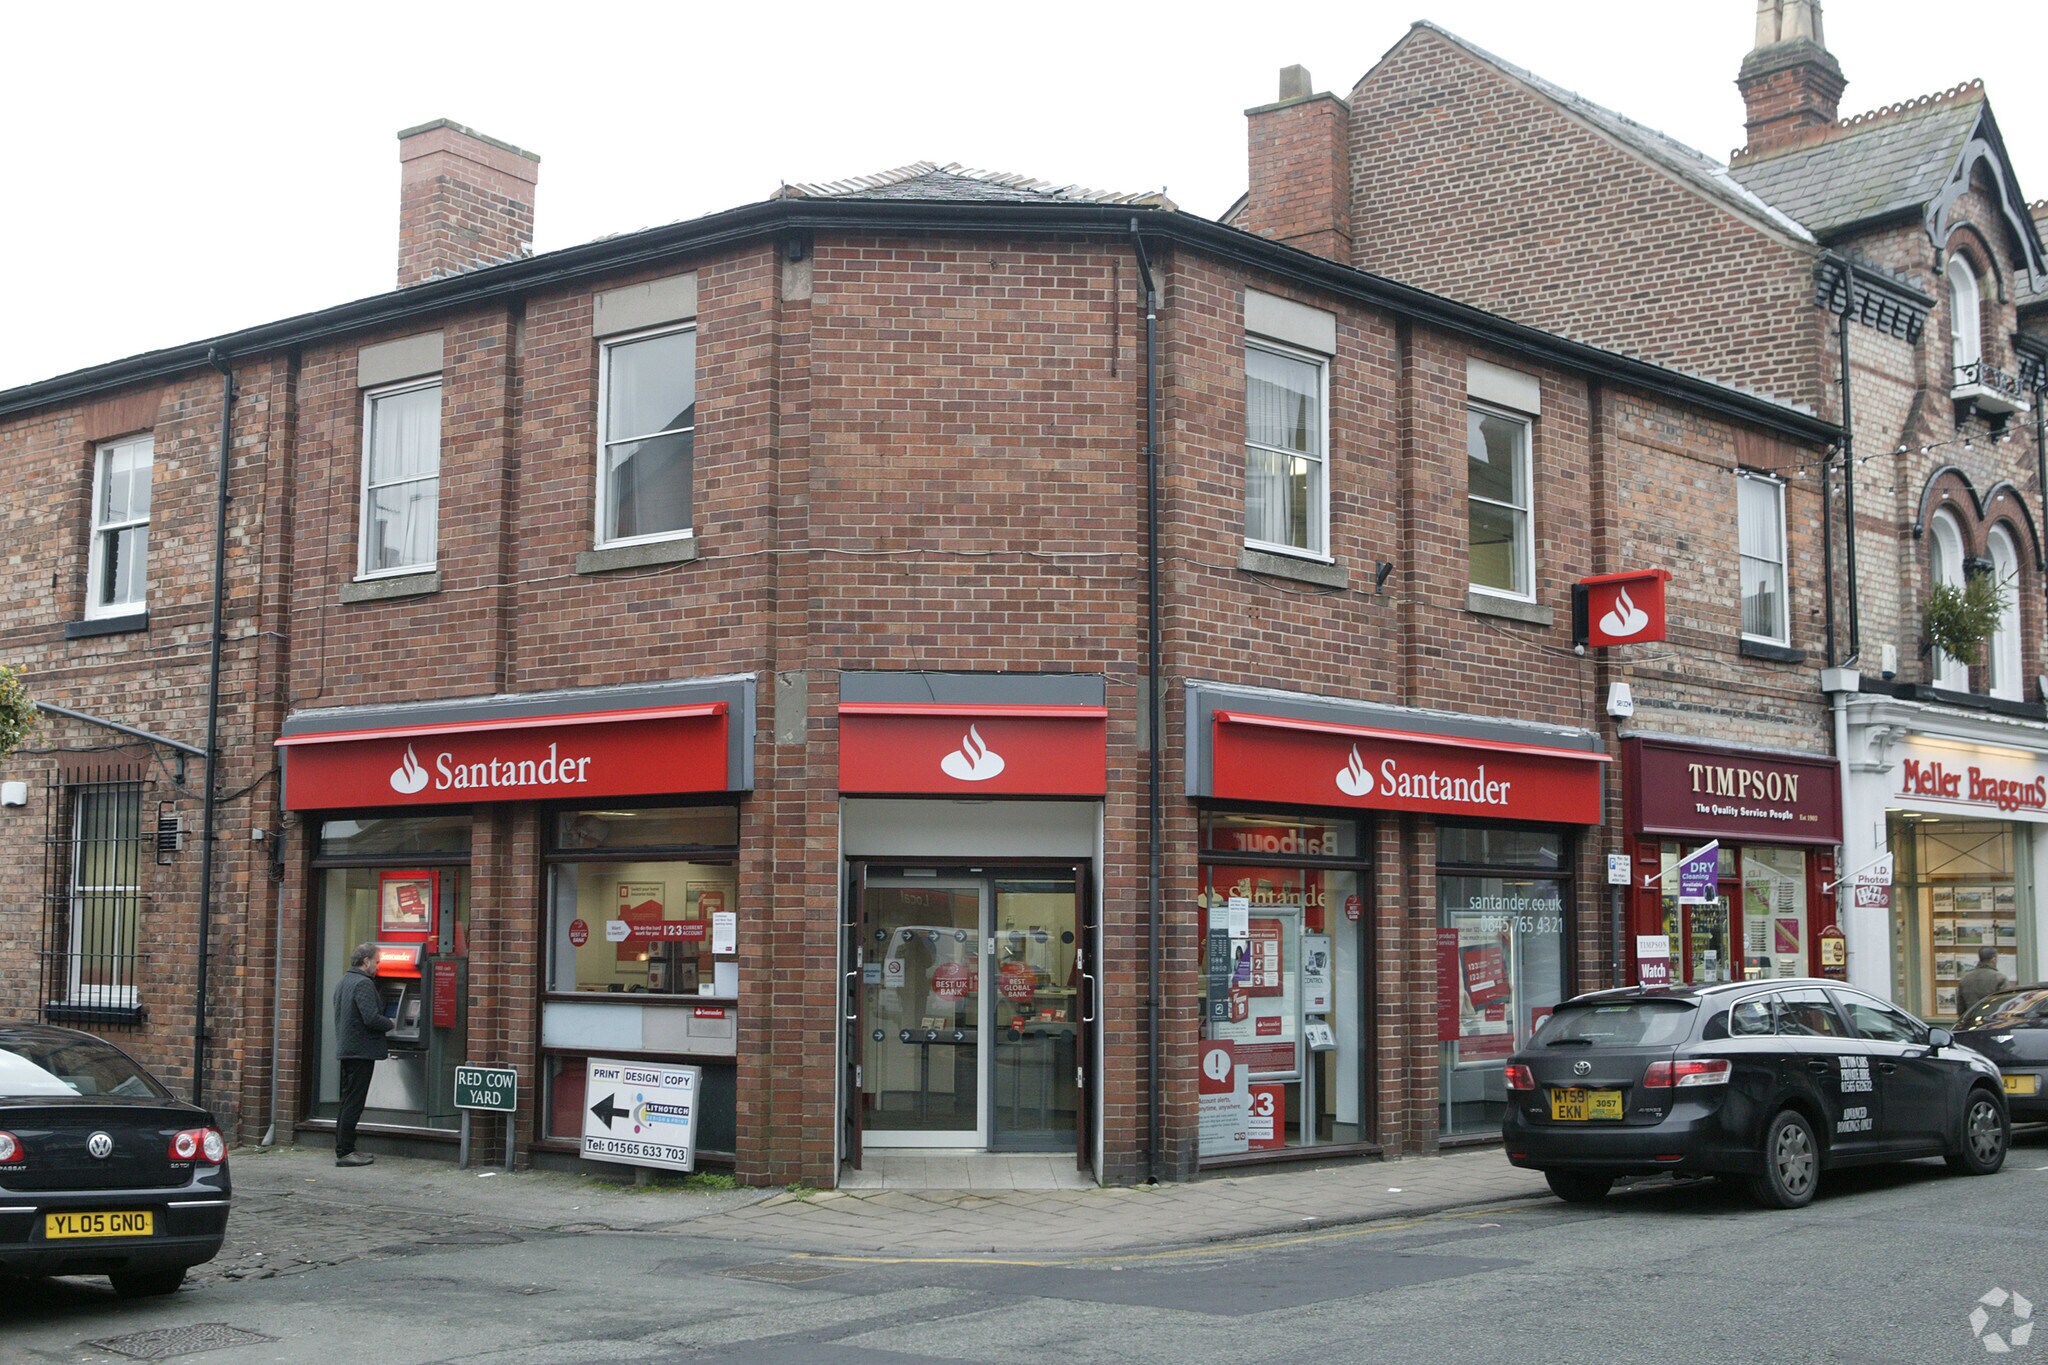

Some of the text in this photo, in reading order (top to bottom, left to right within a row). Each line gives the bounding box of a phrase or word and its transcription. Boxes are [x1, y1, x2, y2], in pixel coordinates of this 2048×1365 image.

[435, 742, 592, 790] Santander
[1380, 758, 1511, 805] Santander
[1688, 763, 1799, 802] TIMPSON
[1903, 758, 1962, 799] Meller
[1696, 803, 1793, 820] The Quality Service People
[1691, 862, 1715, 873] DRY
[1874, 866, 1889, 875] I.D.
[1682, 873, 1710, 881] Cleaning
[1858, 875, 1889, 884] Photos
[1469, 893, 1563, 911] santander.co.uk
[1481, 915, 1563, 933] 0845 765 4321
[1640, 941, 1667, 949] TIMPSON
[380, 951, 411, 961] Santander
[1641, 962, 1666, 978] Watch
[935, 980, 968, 988] BEST UK
[940, 988, 963, 996] BANK
[458, 1070, 514, 1089] RED COW
[593, 1068, 621, 1080] PRINT
[625, 1070, 659, 1084] DESIGN
[664, 1075, 691, 1087] COPY
[469, 1089, 502, 1106] YARD
[1554, 1089, 1585, 1103] MT59
[1596, 1099, 1617, 1107] 3057
[646, 1104, 689, 1115] LITHOTECH
[1558, 1105, 1582, 1118] EKN
[587, 1138, 685, 1161] Tel: 01565 633 703
[54, 1213, 146, 1234] YL05 GNO
